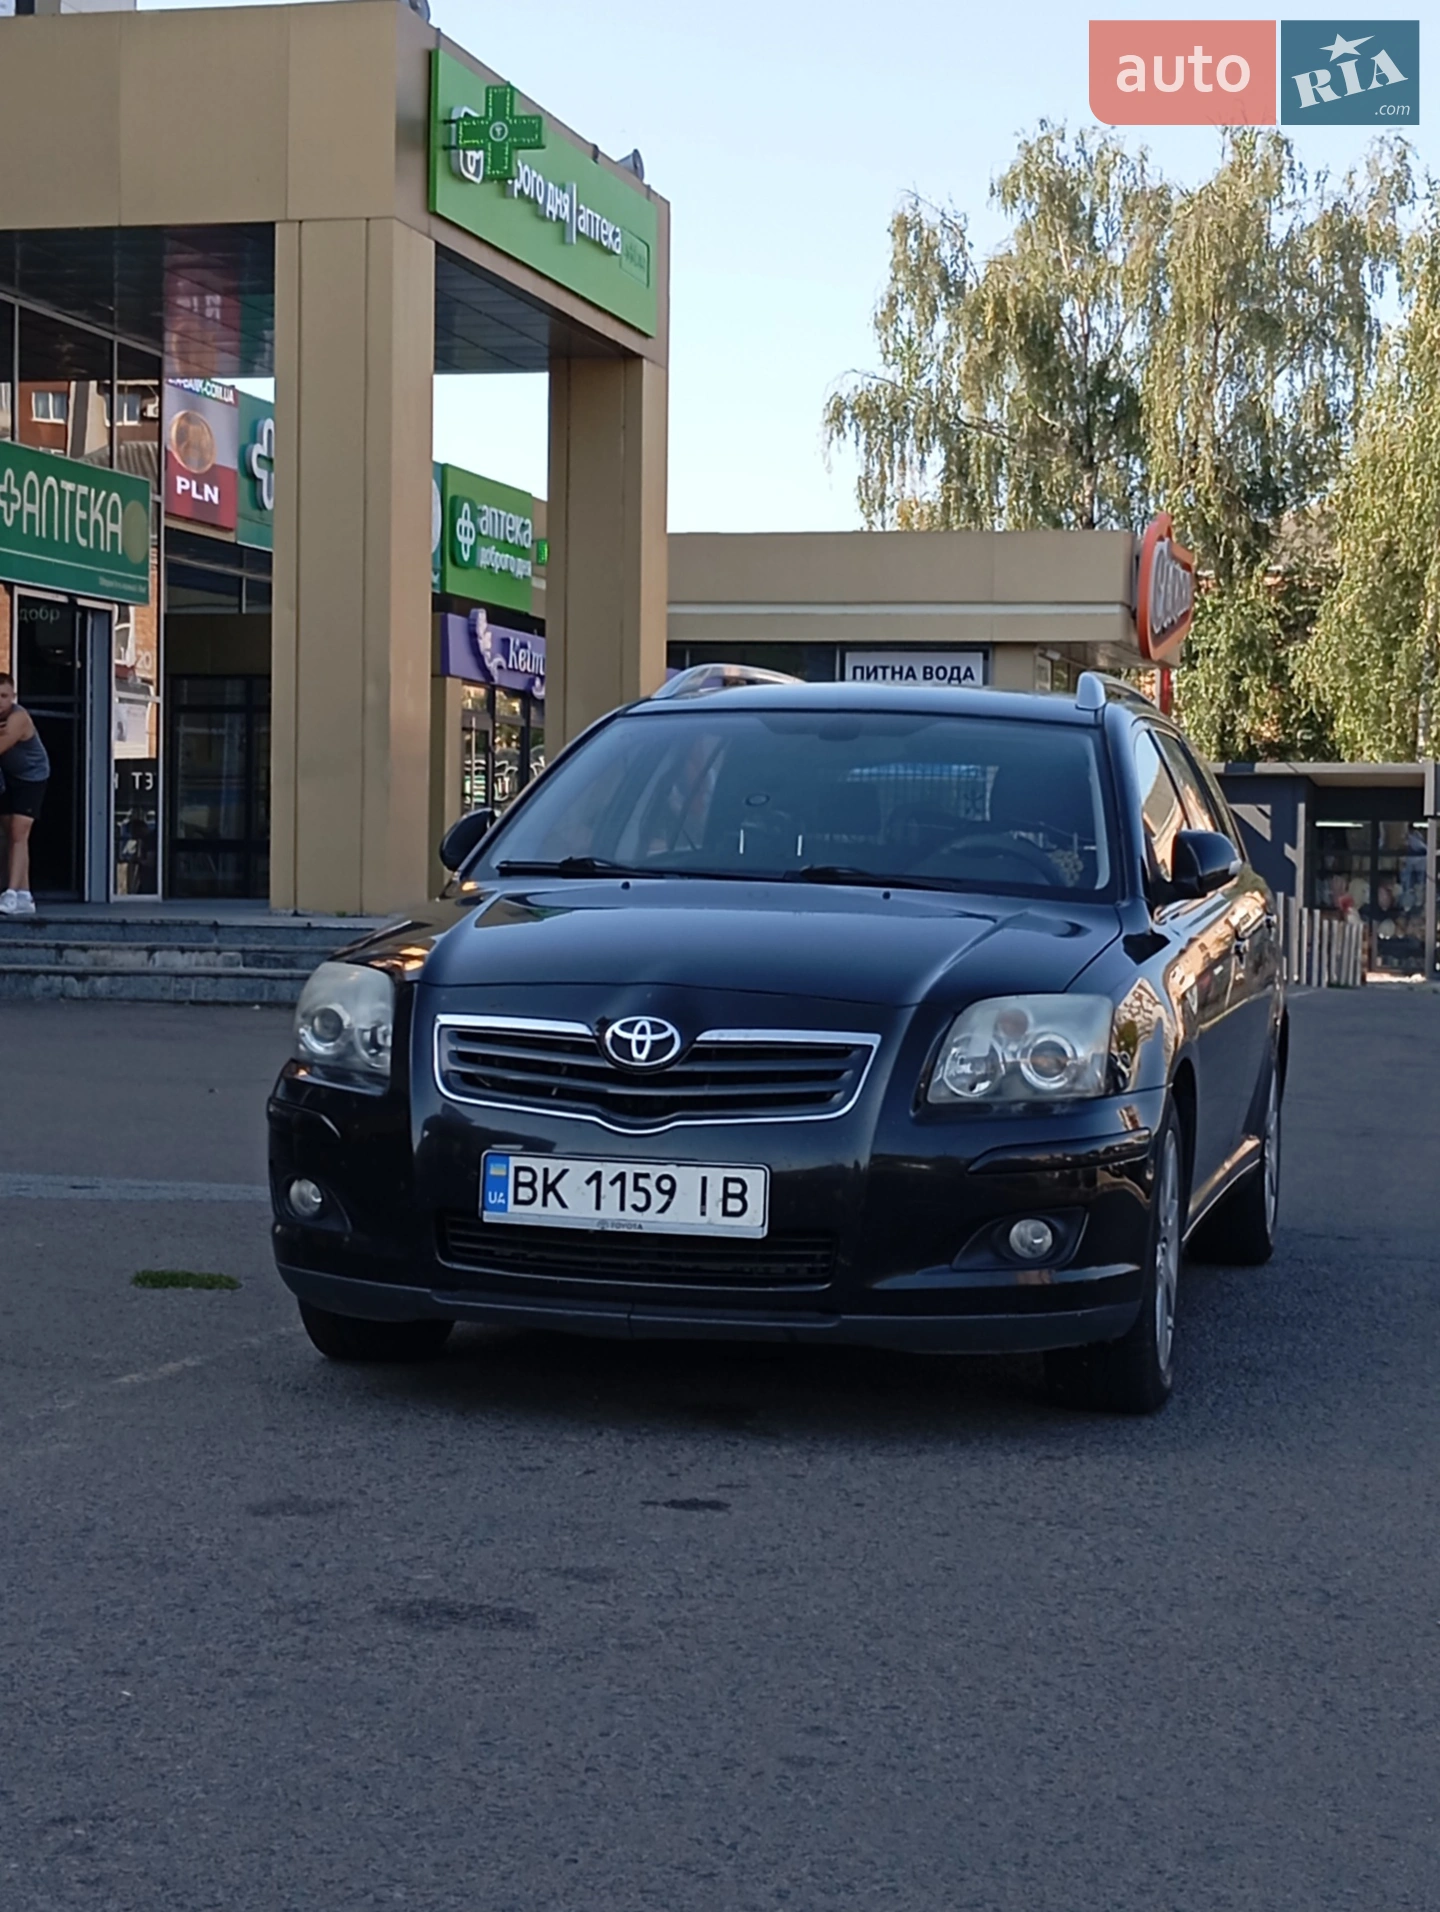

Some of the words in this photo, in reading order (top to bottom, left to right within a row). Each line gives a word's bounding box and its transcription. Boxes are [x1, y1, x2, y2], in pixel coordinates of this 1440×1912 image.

[546, 181, 570, 223] дня
[578, 203, 621, 255] аптека
[176, 475, 220, 505] PLN
[22, 470, 123, 556] АПТЕКА
[478, 504, 532, 549] аптека
[852, 664, 918, 681] ПИТНА
[922, 664, 975, 685] ВОДА
[488, 1190, 506, 1205] UA
[513, 1165, 570, 1209] BK
[584, 1170, 677, 1215] 1159
[700, 1175, 748, 1218] IB
[610, 1221, 643, 1231] TOYOTA
